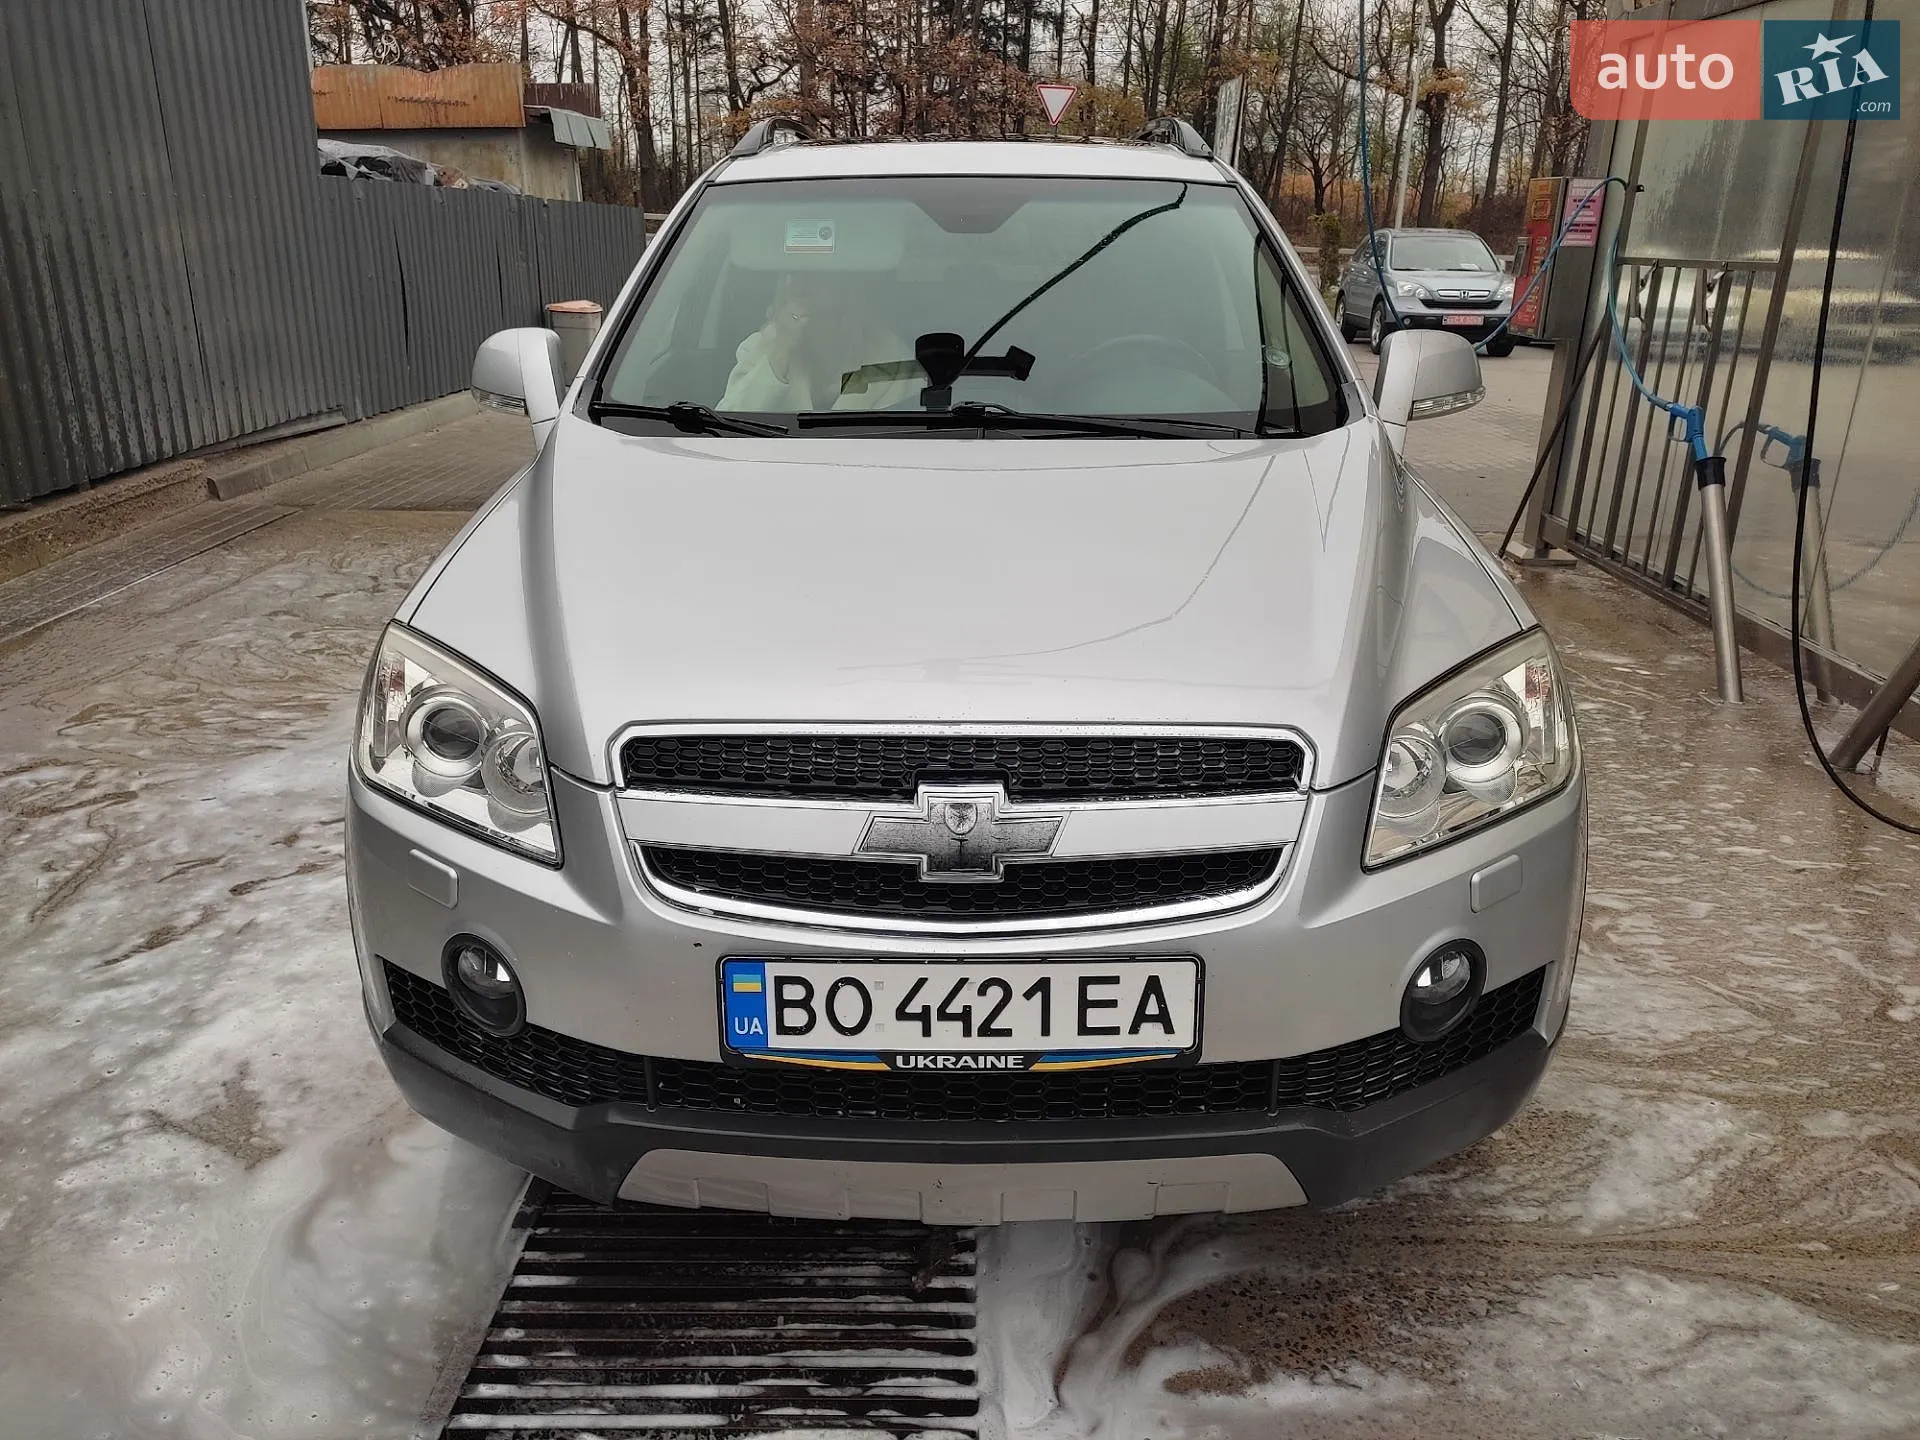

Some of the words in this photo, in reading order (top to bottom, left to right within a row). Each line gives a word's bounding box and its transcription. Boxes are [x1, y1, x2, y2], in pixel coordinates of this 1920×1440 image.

[773, 975, 873, 1037] BO
[895, 976, 1051, 1038] 4421
[1077, 975, 1176, 1036] EA
[734, 1016, 764, 1035] UA
[895, 1055, 1025, 1070] UKRAINE
